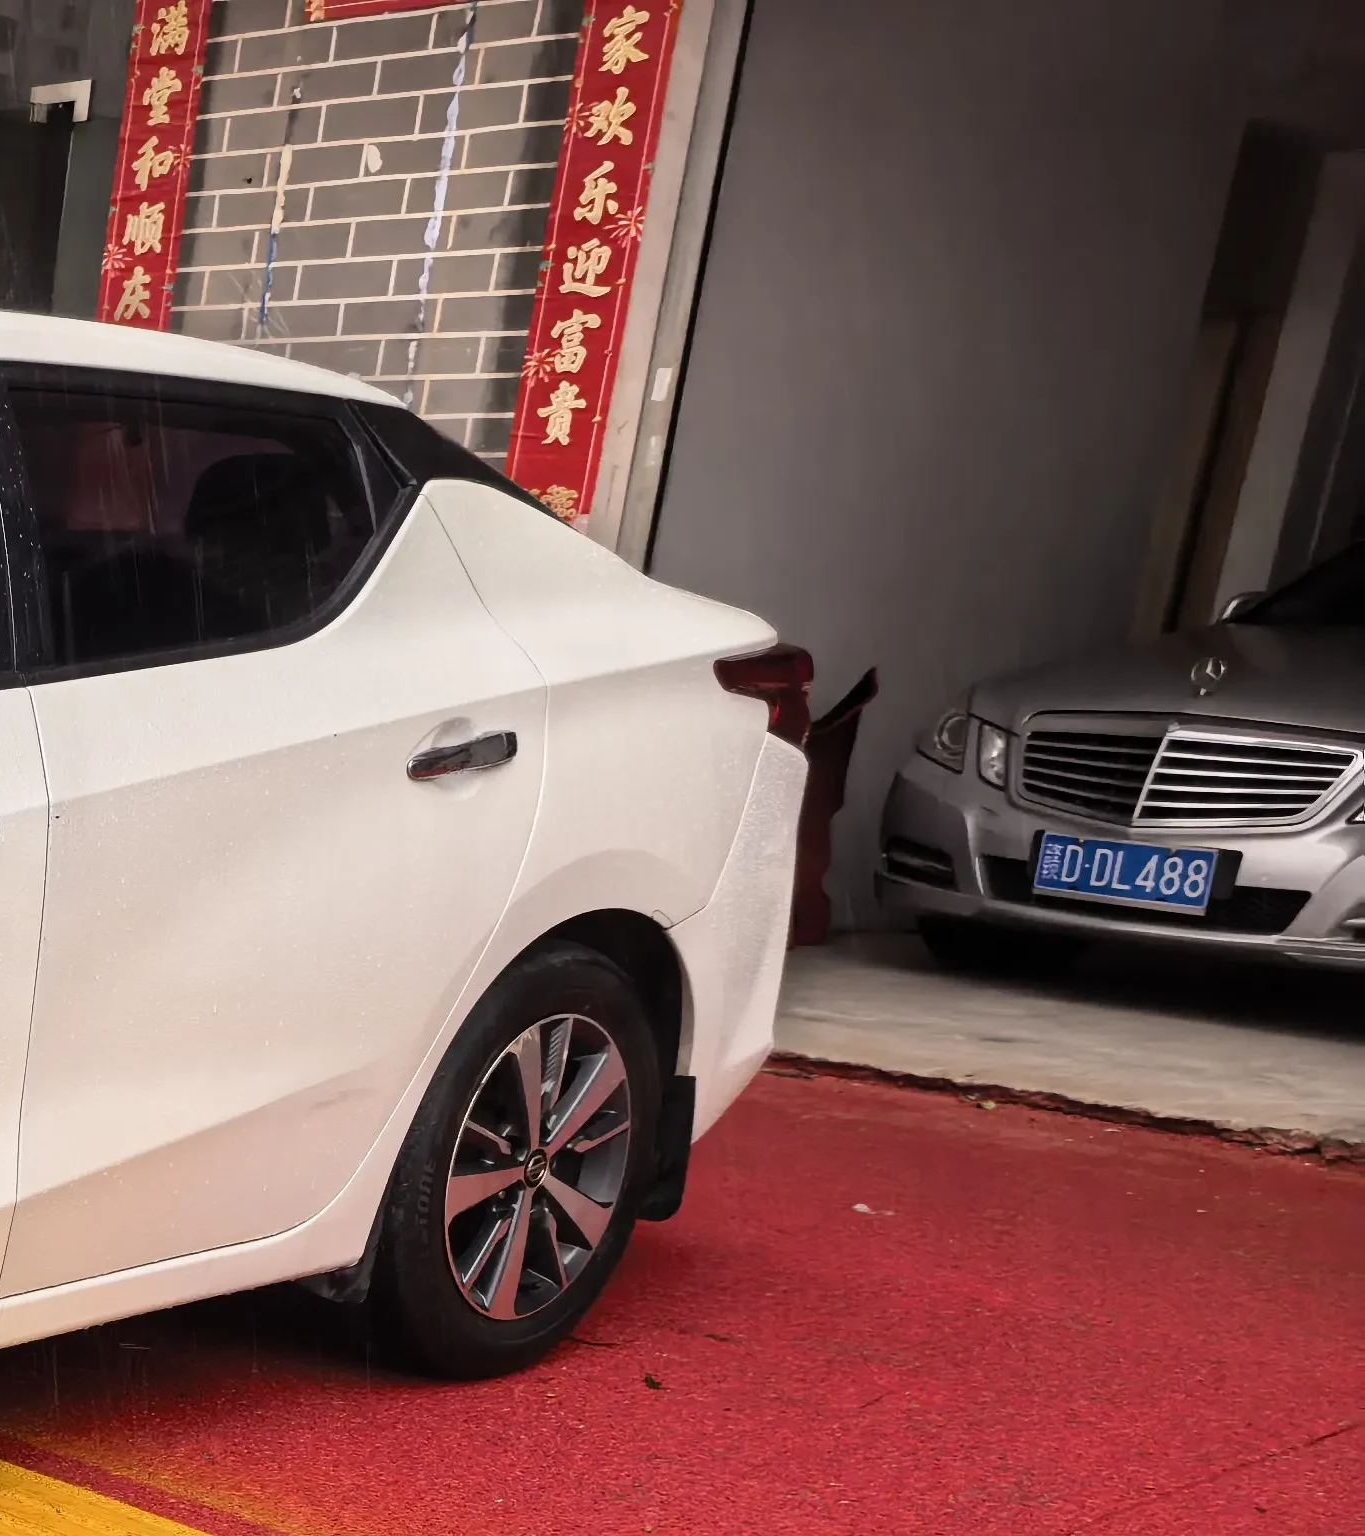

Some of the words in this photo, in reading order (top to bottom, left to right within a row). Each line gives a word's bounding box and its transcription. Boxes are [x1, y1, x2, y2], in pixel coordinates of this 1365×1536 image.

[114, 0, 190, 322] 满堂和顺庆
[537, 5, 650, 446] 家欢乐迎富贵
